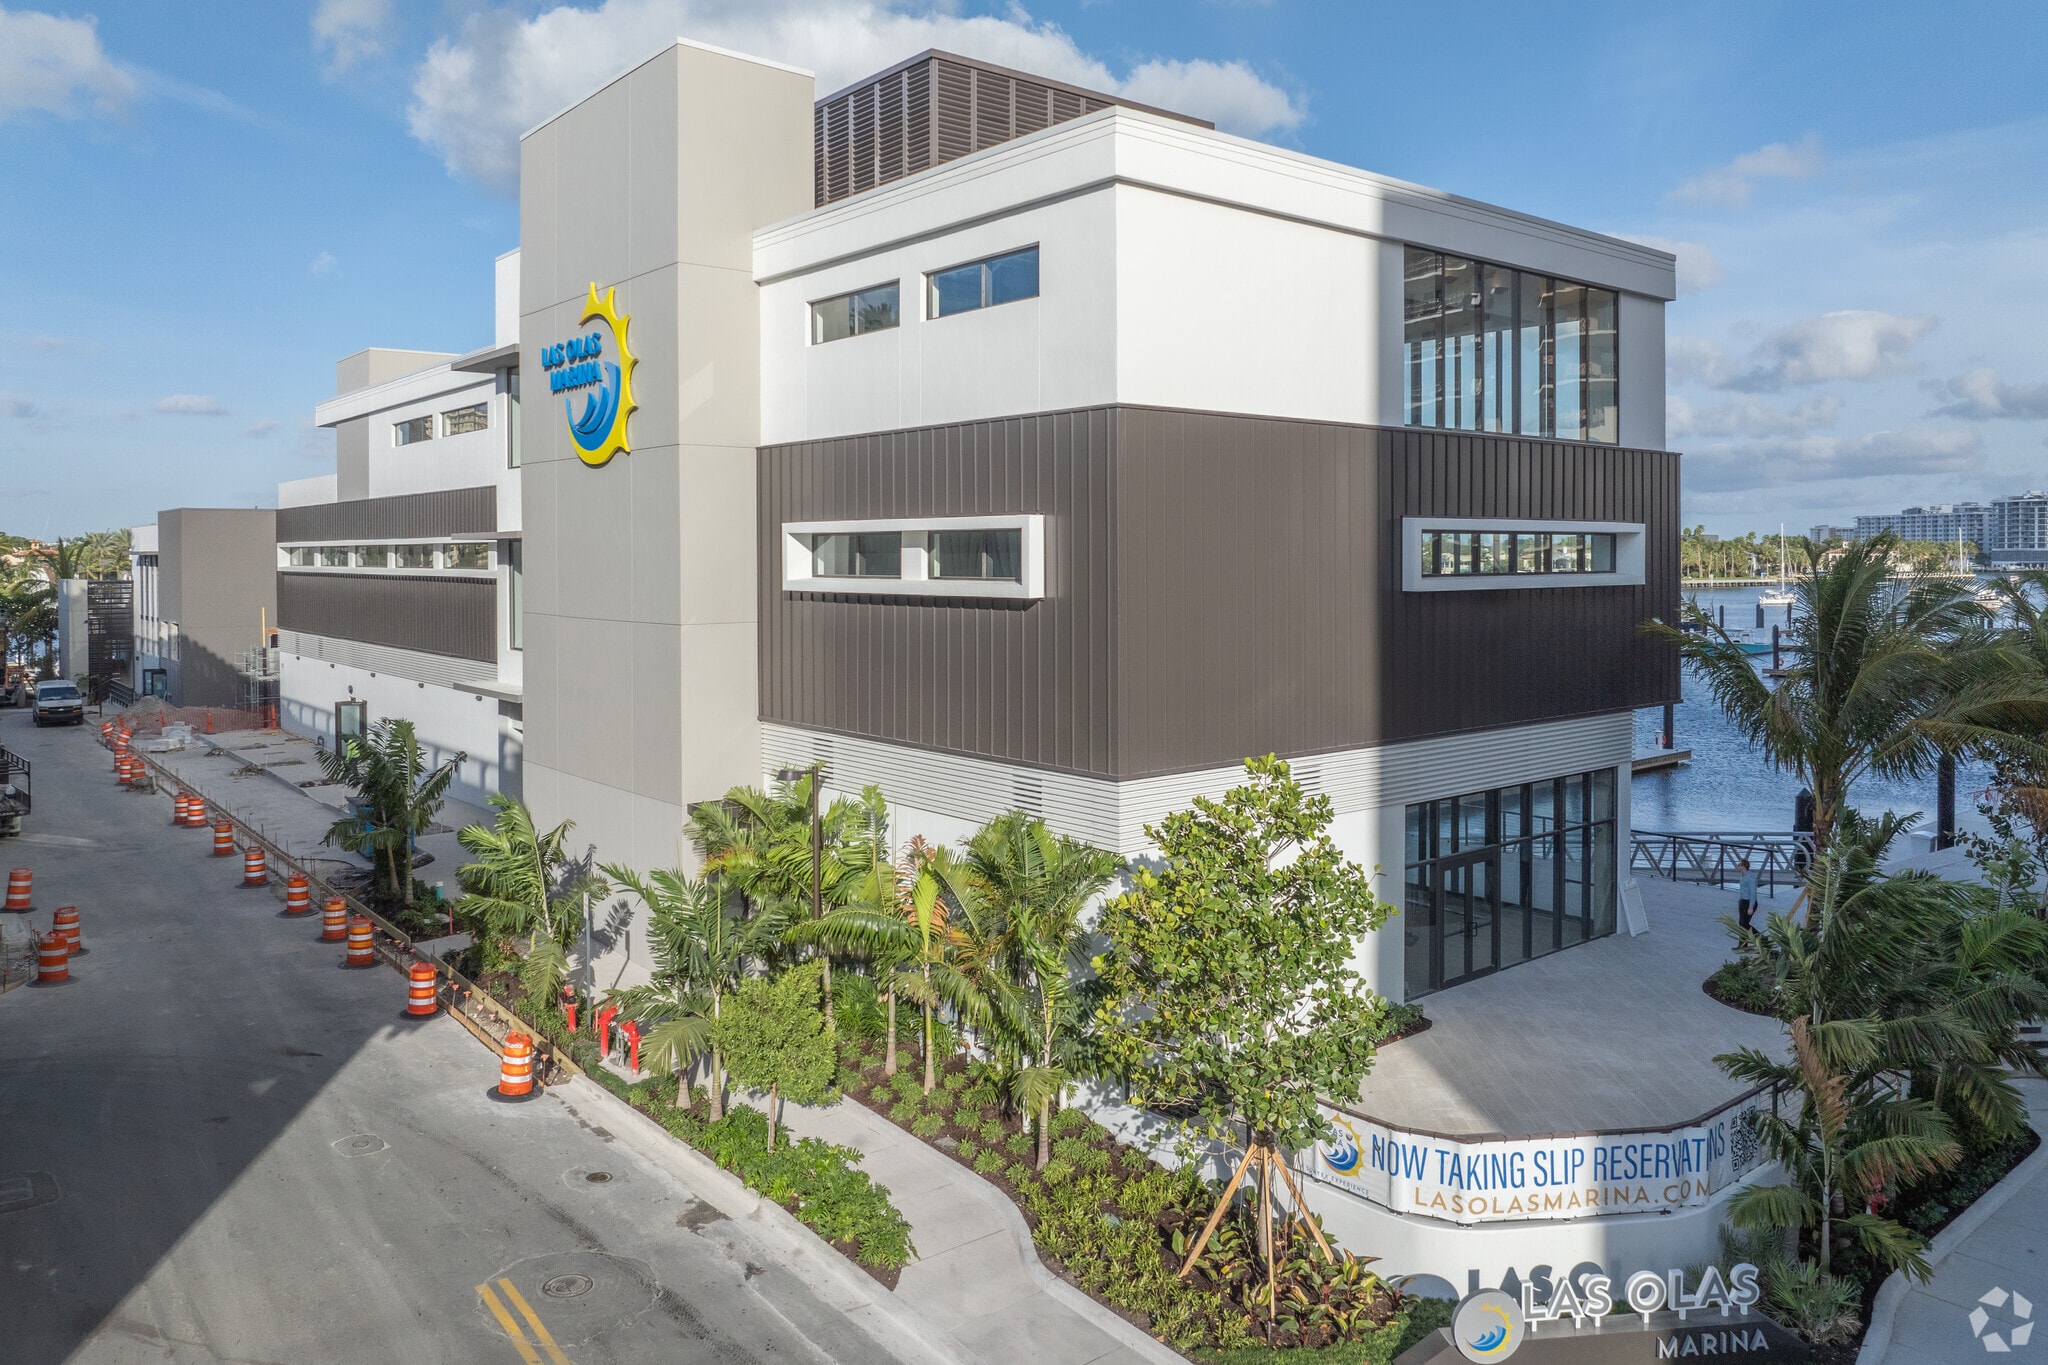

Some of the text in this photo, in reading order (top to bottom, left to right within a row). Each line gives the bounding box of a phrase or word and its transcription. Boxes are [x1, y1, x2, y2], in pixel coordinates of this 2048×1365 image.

[541, 331, 602, 368] LAS OLAS
[550, 359, 602, 391] MARINA
[1371, 1133, 1428, 1182] NOW
[1434, 1148, 1526, 1191] TAKING
[1533, 1147, 1585, 1187] SLIP
[1331, 1176, 1370, 1196] EXPERIENCE
[1415, 1177, 1711, 1216] LASOLASMARINA.COM
[1521, 1262, 1761, 1322] LAS OLAS
[1655, 1328, 1770, 1360] MARINA
